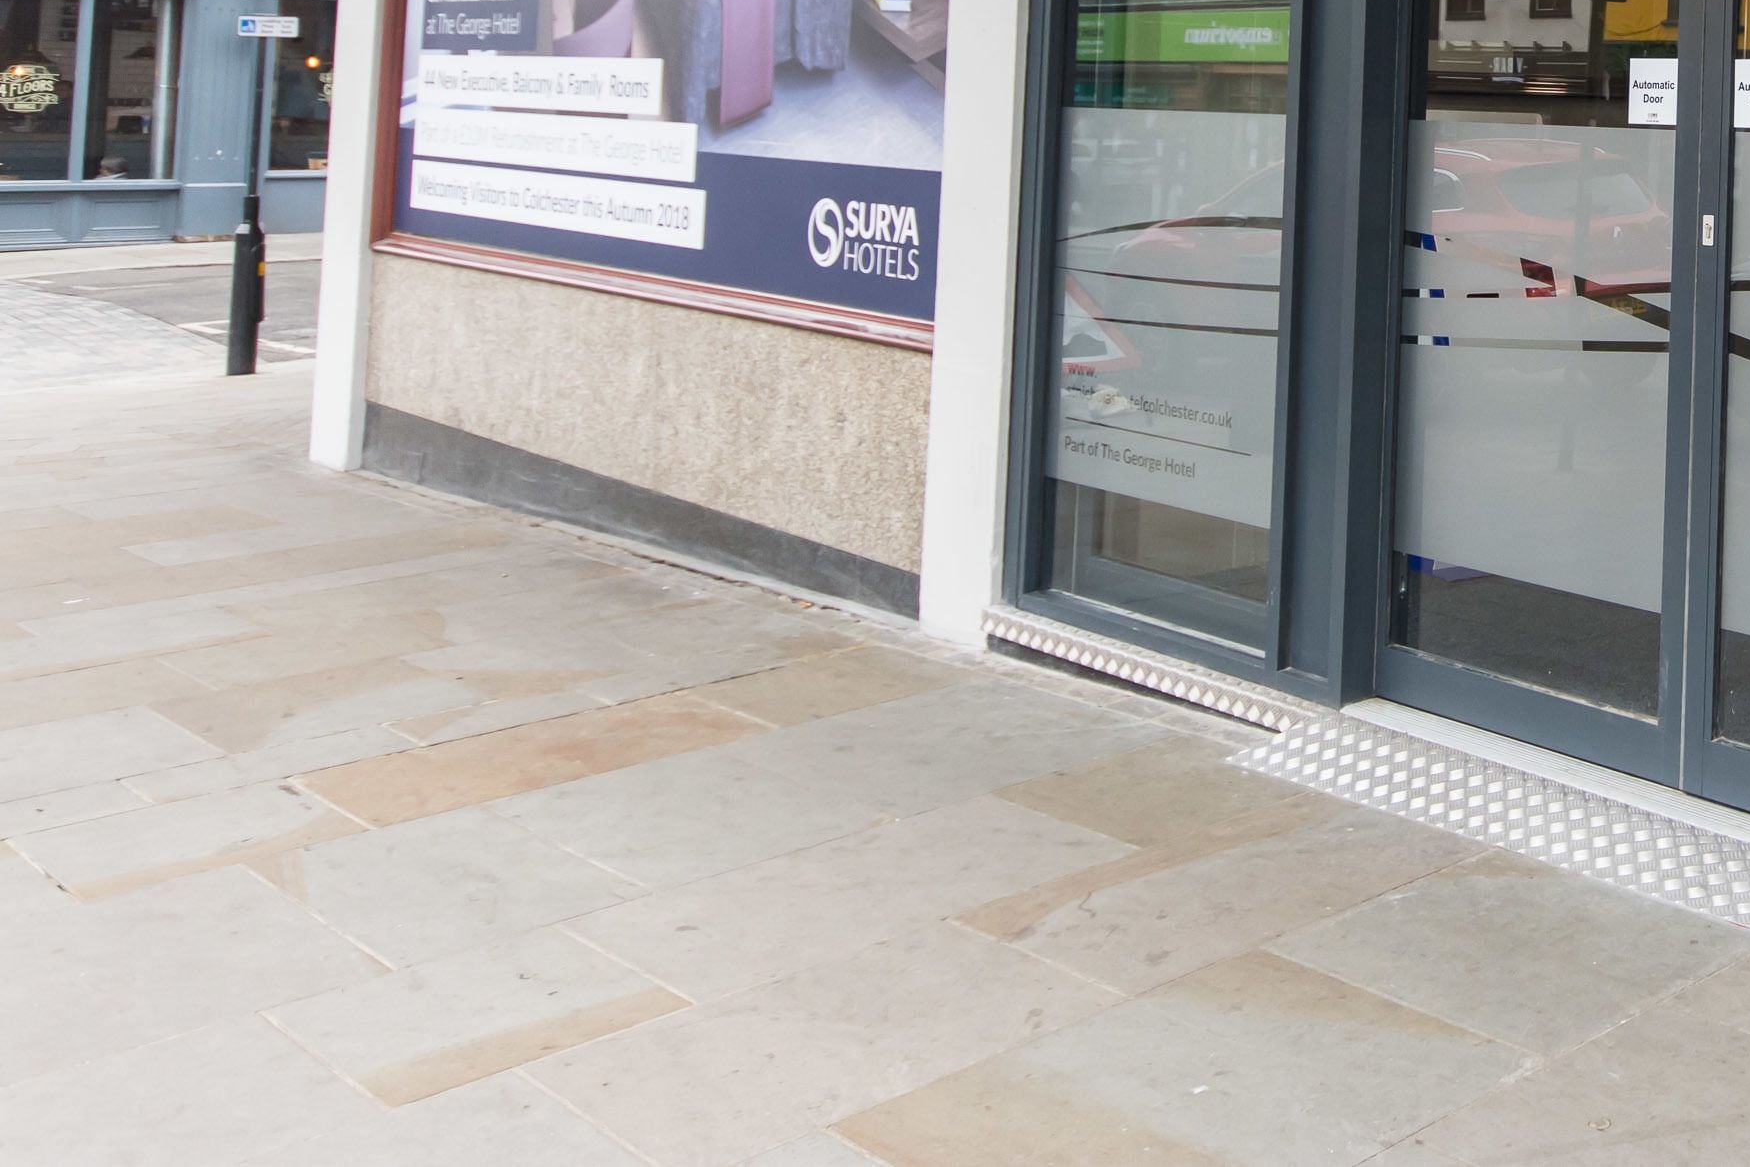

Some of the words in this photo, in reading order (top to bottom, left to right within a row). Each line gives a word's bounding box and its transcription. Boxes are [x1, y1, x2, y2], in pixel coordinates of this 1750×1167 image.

[425, 16, 436, 34] at
[437, 13, 455, 34] The
[456, 13, 491, 40] George
[492, 12, 521, 34] Hotel
[10, 79, 54, 97] FLOORS
[437, 71, 459, 88] New
[513, 72, 552, 98] Balcony
[556, 73, 564, 94] &
[568, 74, 601, 100] Family
[609, 74, 649, 98] Rooms
[1632, 80, 1675, 91] Automatic
[1643, 94, 1664, 104] Door
[580, 131, 601, 157] The
[603, 134, 647, 166] George
[651, 138, 683, 164] Hotel
[418, 174, 468, 206] Welcoming
[470, 179, 505, 206] Visitors
[509, 188, 519, 208] to
[522, 186, 580, 216] Colchester
[582, 194, 603, 219] this
[606, 197, 653, 226] Autumn
[657, 202, 690, 231] 2018
[845, 200, 919, 246] SURYA
[843, 240, 919, 281] HOTELS
[1067, 363, 1098, 379] www.
[1064, 436, 1085, 455] Part
[1088, 442, 1100, 457] of
[1101, 443, 1120, 462] The
[1123, 448, 1162, 473] George
[1164, 457, 1196, 479] Hotel
